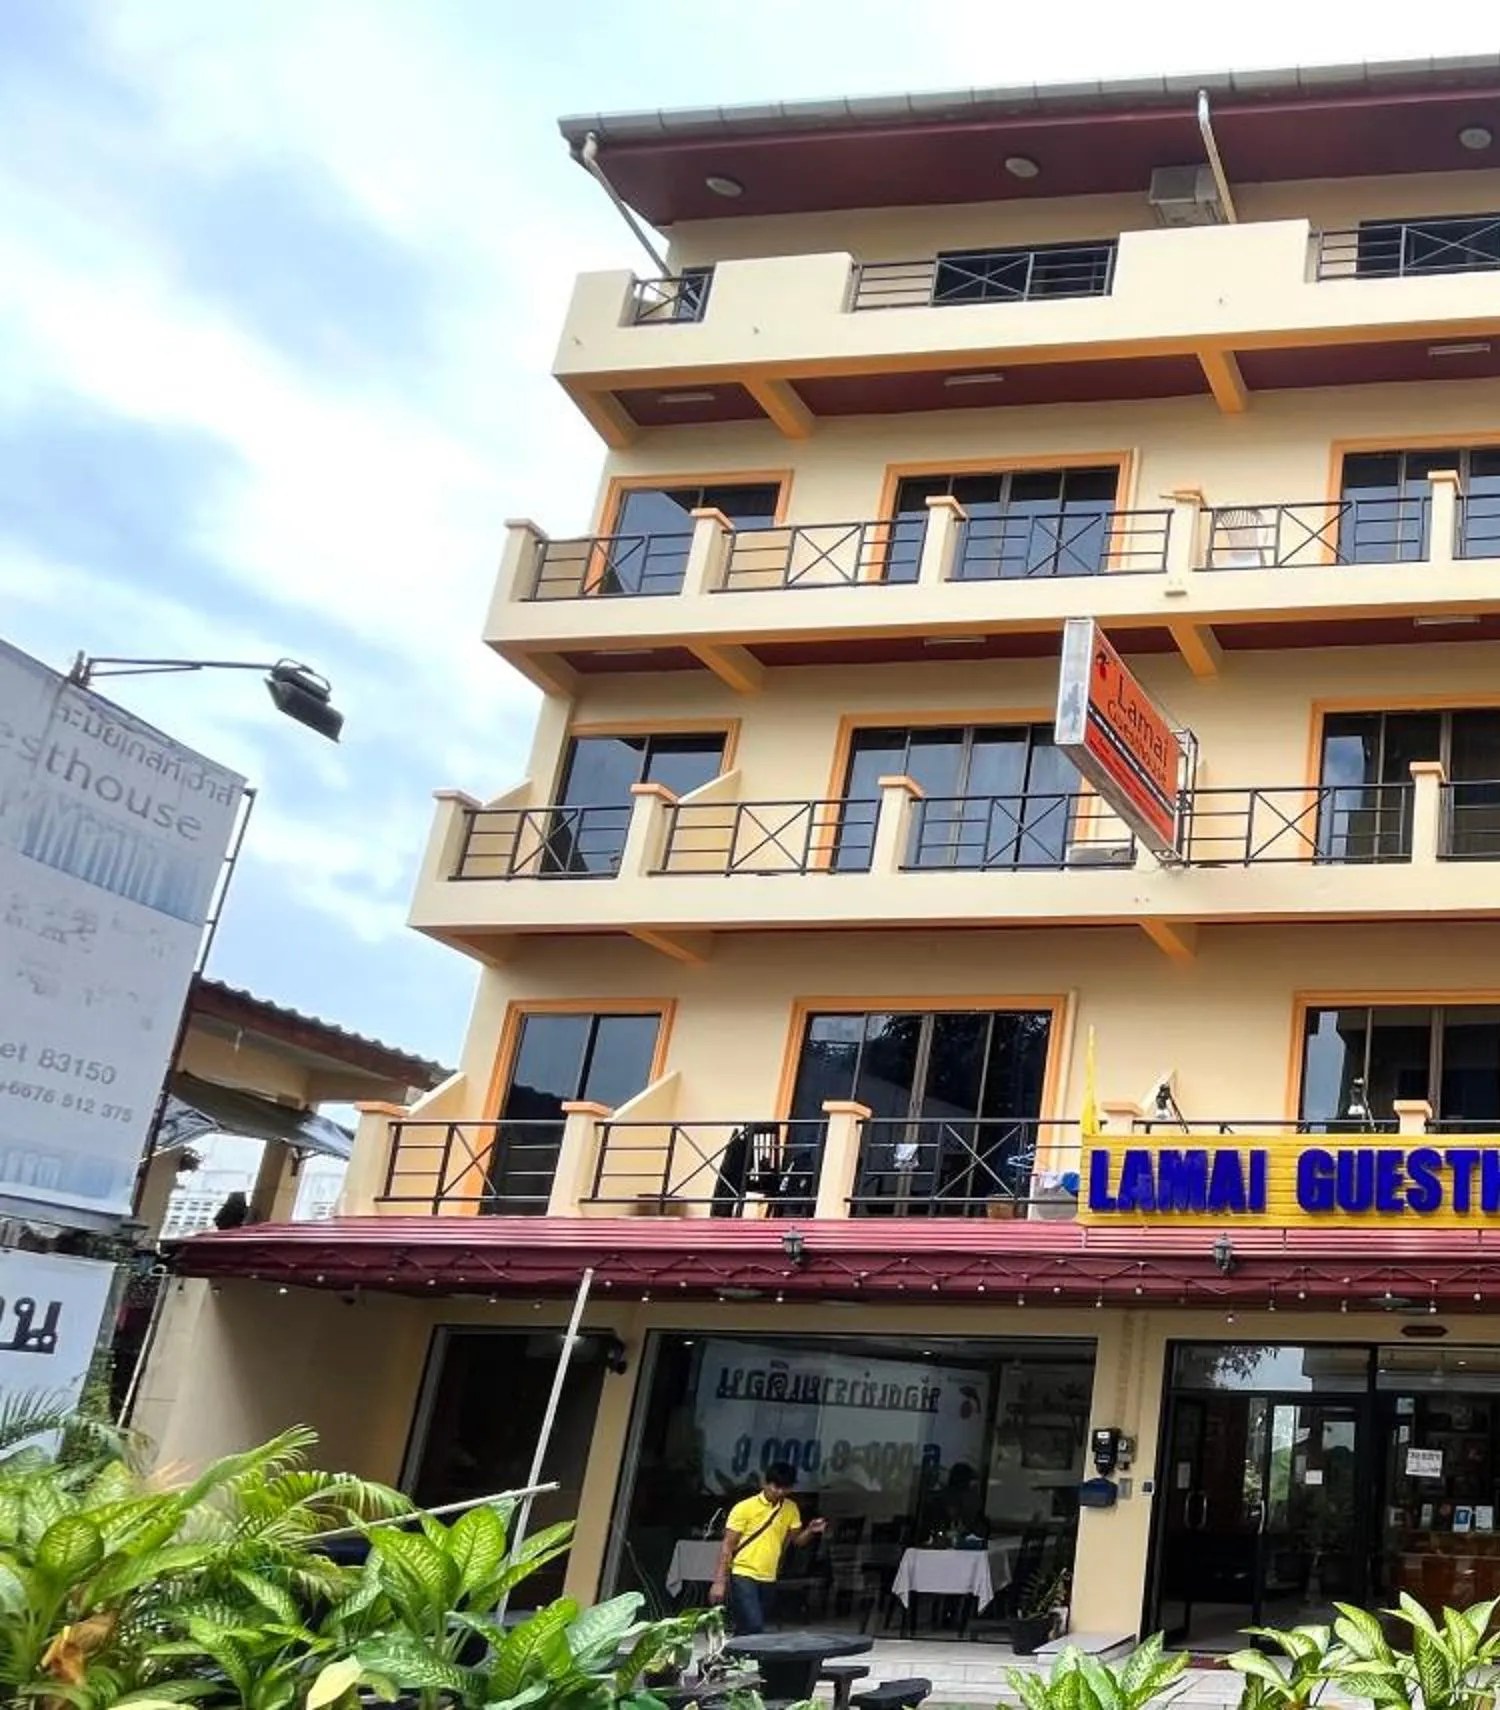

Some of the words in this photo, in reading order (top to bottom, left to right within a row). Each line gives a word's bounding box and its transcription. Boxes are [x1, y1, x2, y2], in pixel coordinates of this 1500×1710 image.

[1117, 674, 1167, 768] Lamai
[61, 1092, 95, 1114] 512
[101, 1103, 134, 1123] 375
[1088, 1149, 1267, 1213] LAMAI
